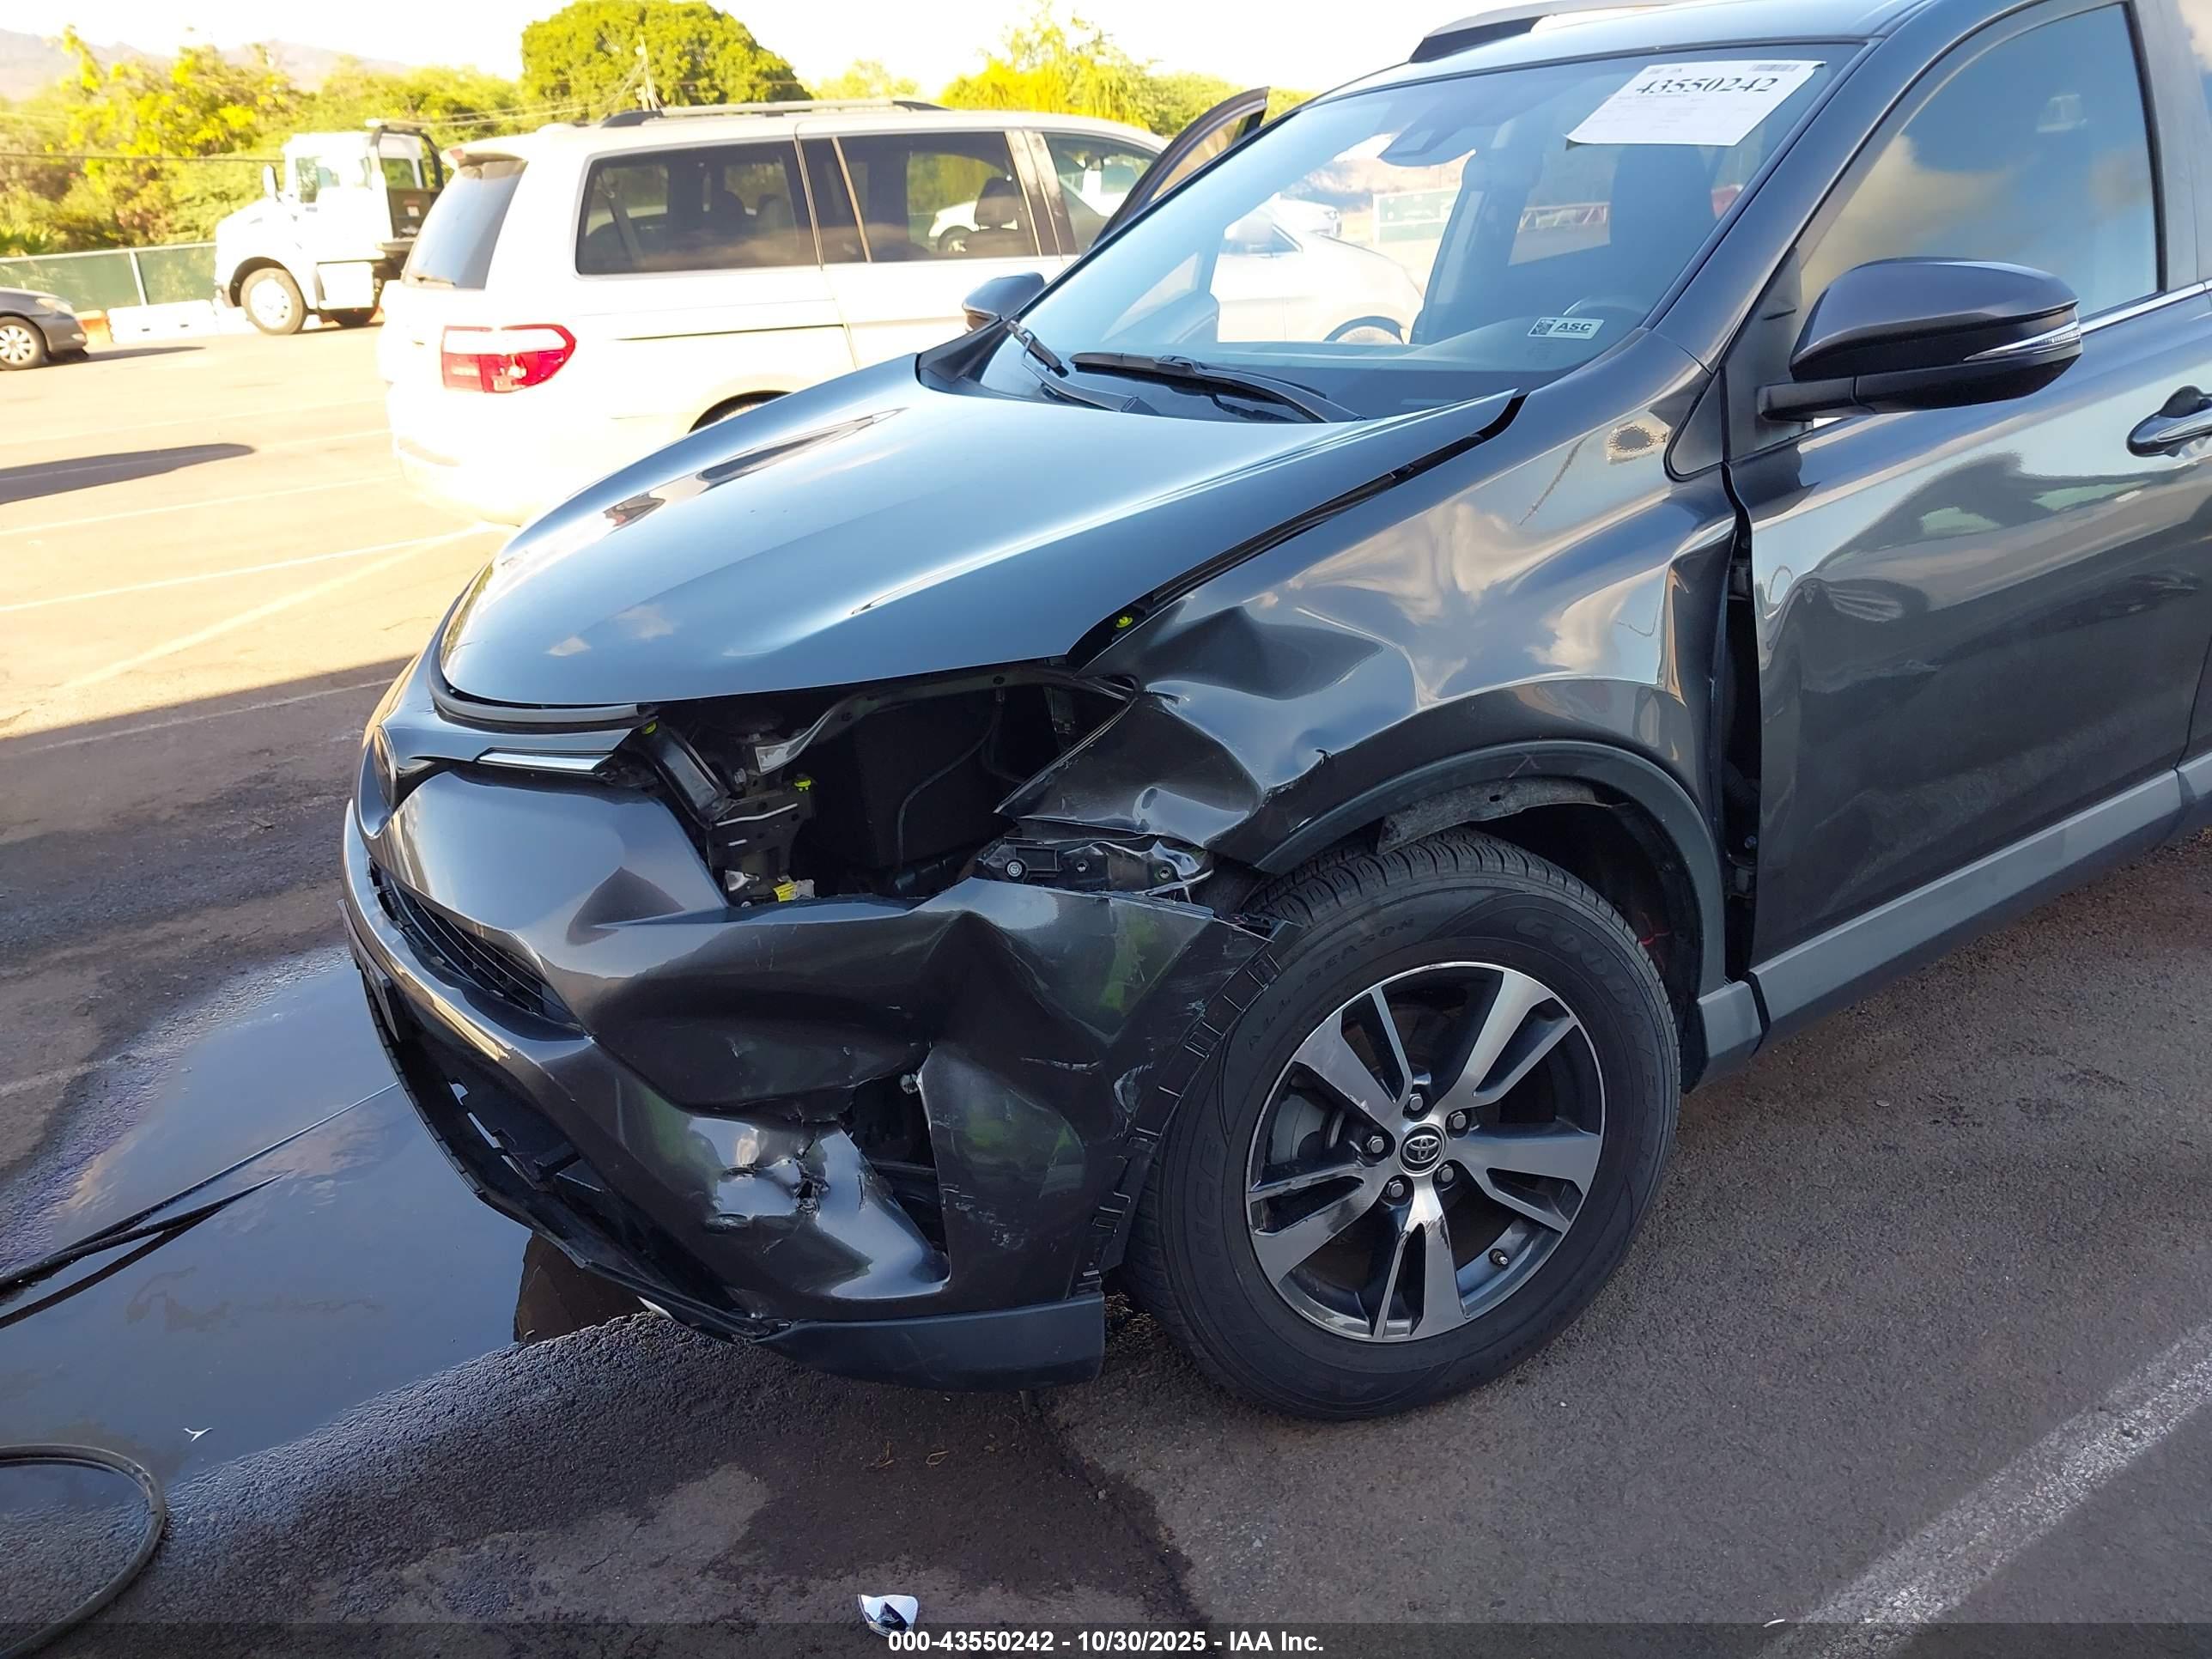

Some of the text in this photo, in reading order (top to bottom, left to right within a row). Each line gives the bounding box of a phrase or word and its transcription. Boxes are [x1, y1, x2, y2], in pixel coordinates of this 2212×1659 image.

[1635, 76, 1779, 94] 43550242
[1555, 322, 1592, 331] ASC
[1249, 919, 1414, 1052] ALL-SEASON
